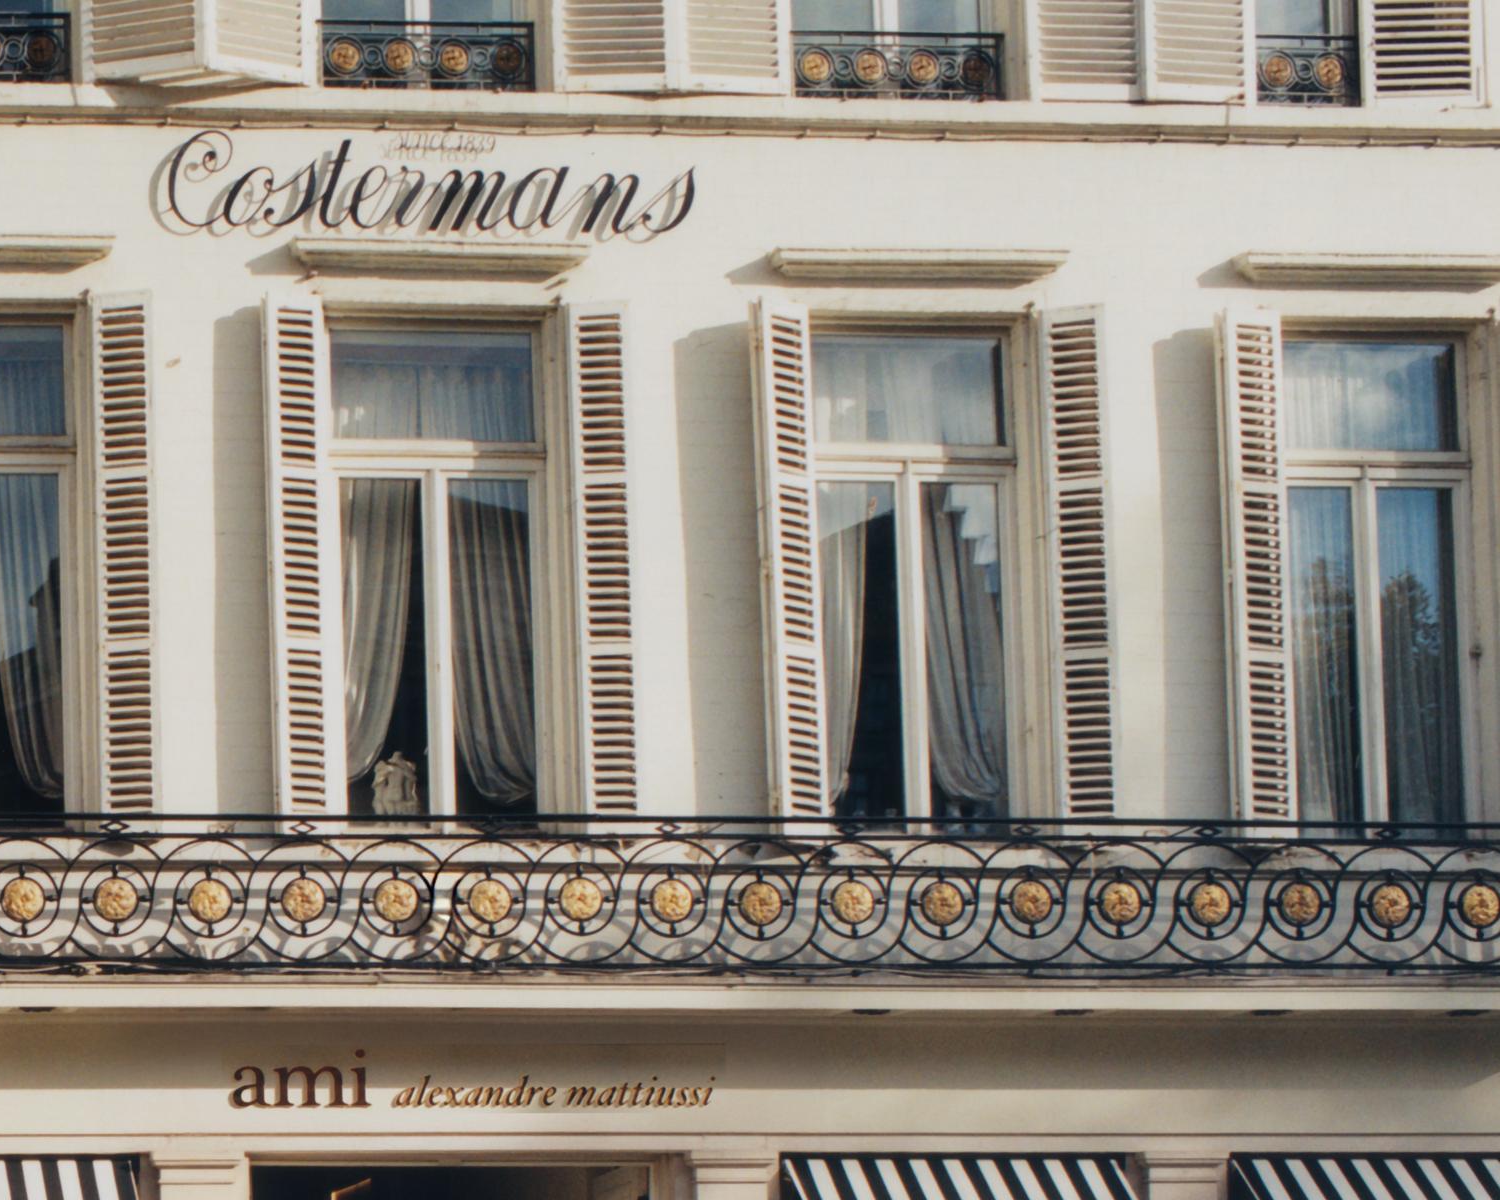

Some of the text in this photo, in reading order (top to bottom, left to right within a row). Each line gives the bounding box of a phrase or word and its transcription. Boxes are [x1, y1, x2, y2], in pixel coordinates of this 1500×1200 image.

[455, 132, 496, 153] 1839
[168, 129, 695, 234] Costermans
[228, 1049, 716, 1109] ami alexandre mattiussi
